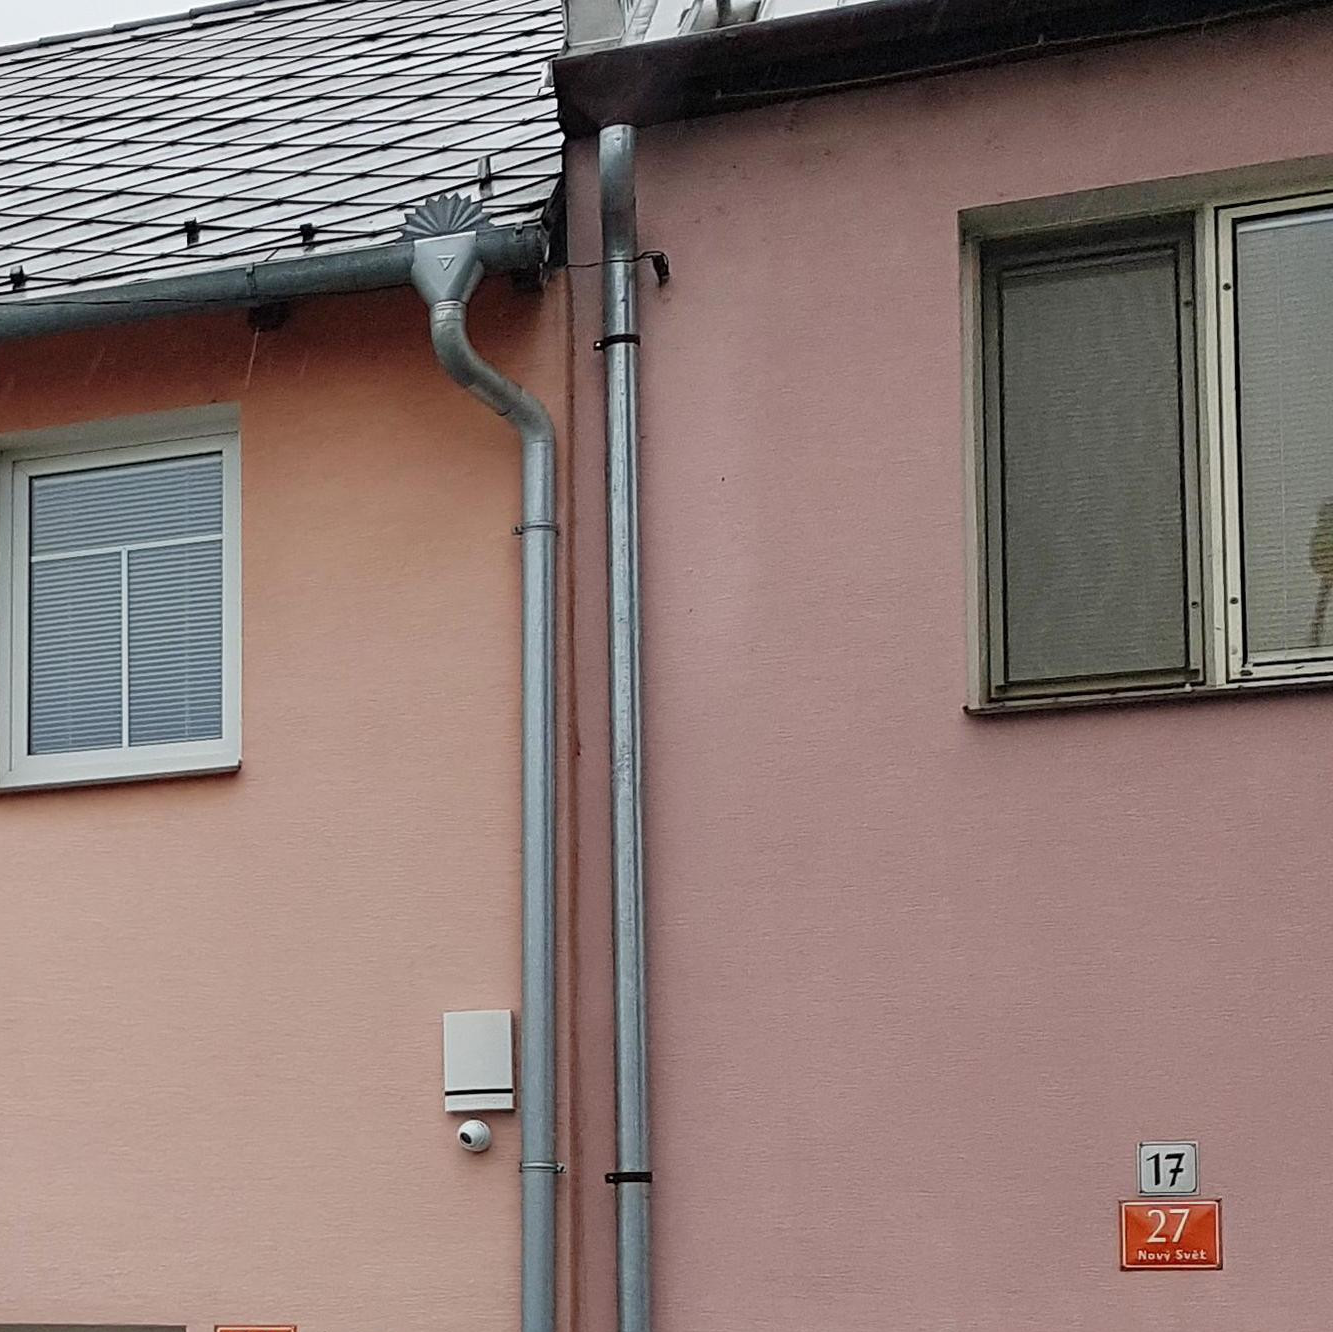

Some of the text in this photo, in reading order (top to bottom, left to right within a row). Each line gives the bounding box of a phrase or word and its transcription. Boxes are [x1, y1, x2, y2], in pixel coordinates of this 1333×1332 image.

[1146, 1152, 1185, 1187] 17
[1146, 1208, 1190, 1243] 27
[1137, 1249, 1207, 1262] Nový Svět
